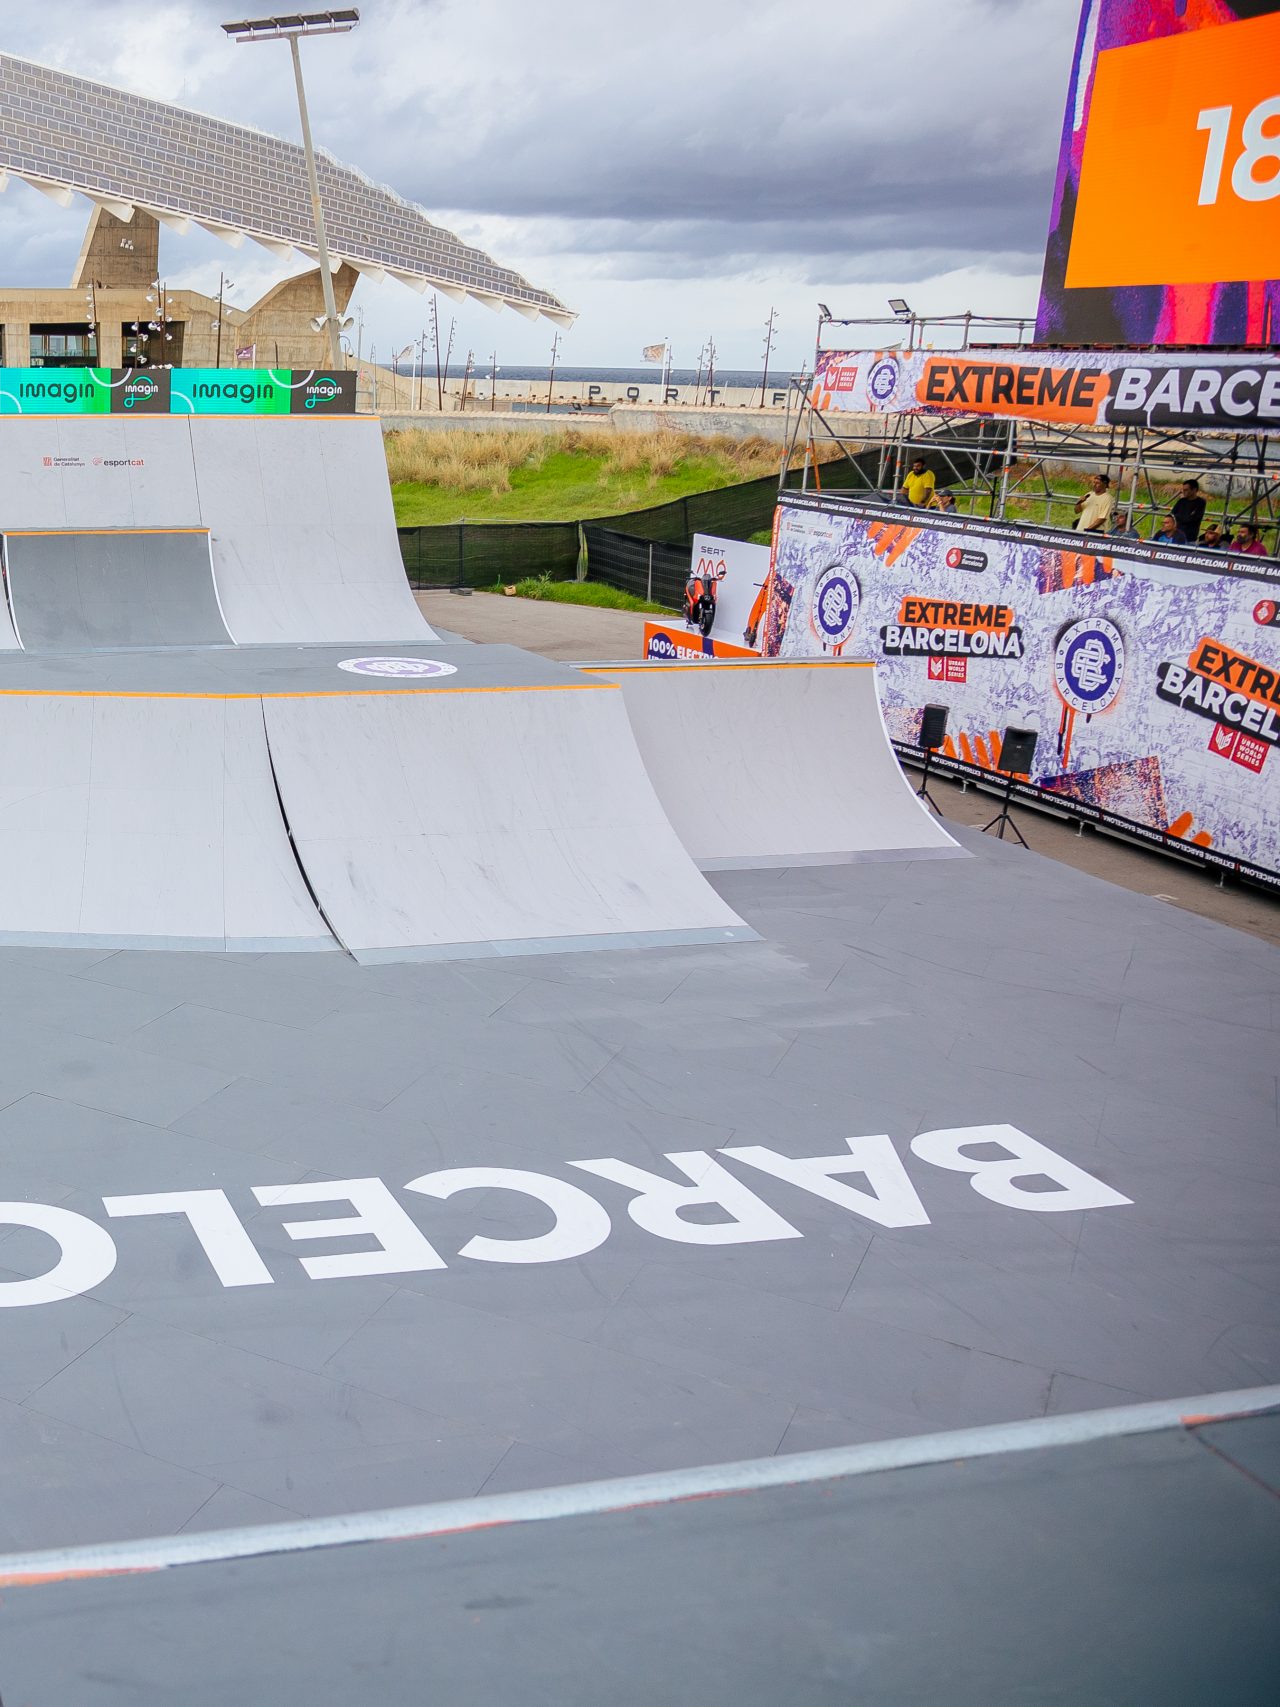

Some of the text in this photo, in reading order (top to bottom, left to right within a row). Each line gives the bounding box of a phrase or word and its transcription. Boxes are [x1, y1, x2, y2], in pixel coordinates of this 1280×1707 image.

[1196, 94, 1280, 206] 18
[20, 383, 95, 403] imagin
[125, 384, 159, 395] imagin
[192, 383, 274, 403] imagin
[306, 385, 343, 396] imagin
[588, 385, 720, 403] PORT
[926, 365, 1101, 408] EXTREME
[1114, 368, 1280, 418] BARCE
[104, 458, 144, 467] esportcat
[839, 505, 864, 514] BARCELONA
[882, 511, 910, 521] BARCELONA
[935, 519, 964, 529] BARCELONA
[967, 524, 990, 533] EXTREME
[990, 527, 1022, 538] BARCELONA
[1025, 533, 1050, 543] EXTREME
[1050, 536, 1084, 547] BARCELONA
[1111, 545, 1151, 558] BARCELONA
[1155, 552, 1186, 563] EXTREME
[1187, 556, 1229, 569] BARCELONA
[1233, 563, 1266, 574] EXTREME
[701, 545, 725, 556] SEAT
[904, 601, 1008, 628] EXTREME
[648, 637, 675, 656] 100%
[886, 626, 1021, 657] BARCELONA
[1064, 620, 1122, 655] EXTREME
[1056, 663, 1121, 711] BARCELONA
[1162, 664, 1279, 740] BARCEL
[1238, 744, 1263, 760] WORLD
[1241, 737, 1265, 753] URBAN
[1236, 751, 1260, 767] SERIES
[1167, 839, 1235, 869] EXTREME BARCELONA
